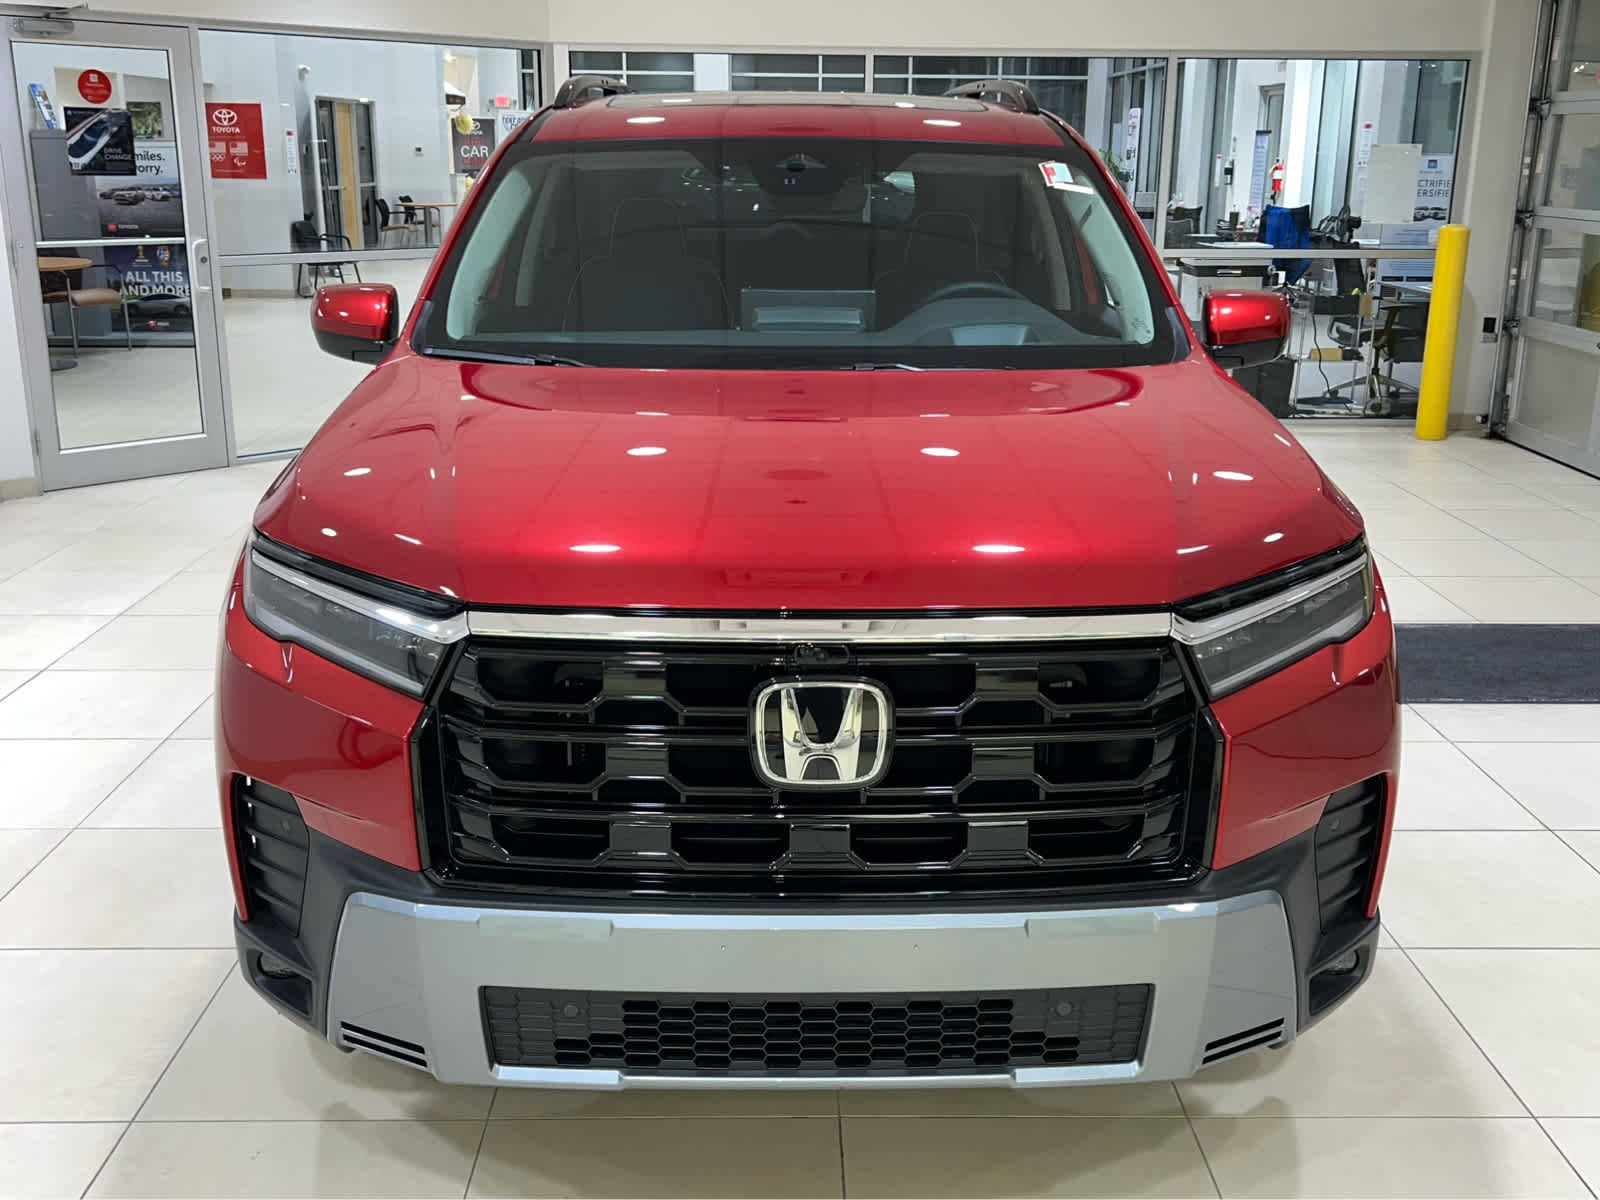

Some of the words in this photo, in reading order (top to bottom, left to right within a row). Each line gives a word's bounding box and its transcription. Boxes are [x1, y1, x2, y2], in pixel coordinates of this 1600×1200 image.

[134, 151, 166, 161] miles.
[460, 145, 489, 158] CAR
[135, 165, 164, 176] orry.
[126, 271, 150, 282] ALL
[151, 271, 183, 282] THIS
[120, 284, 151, 296] AND
[152, 284, 191, 297] MORE
